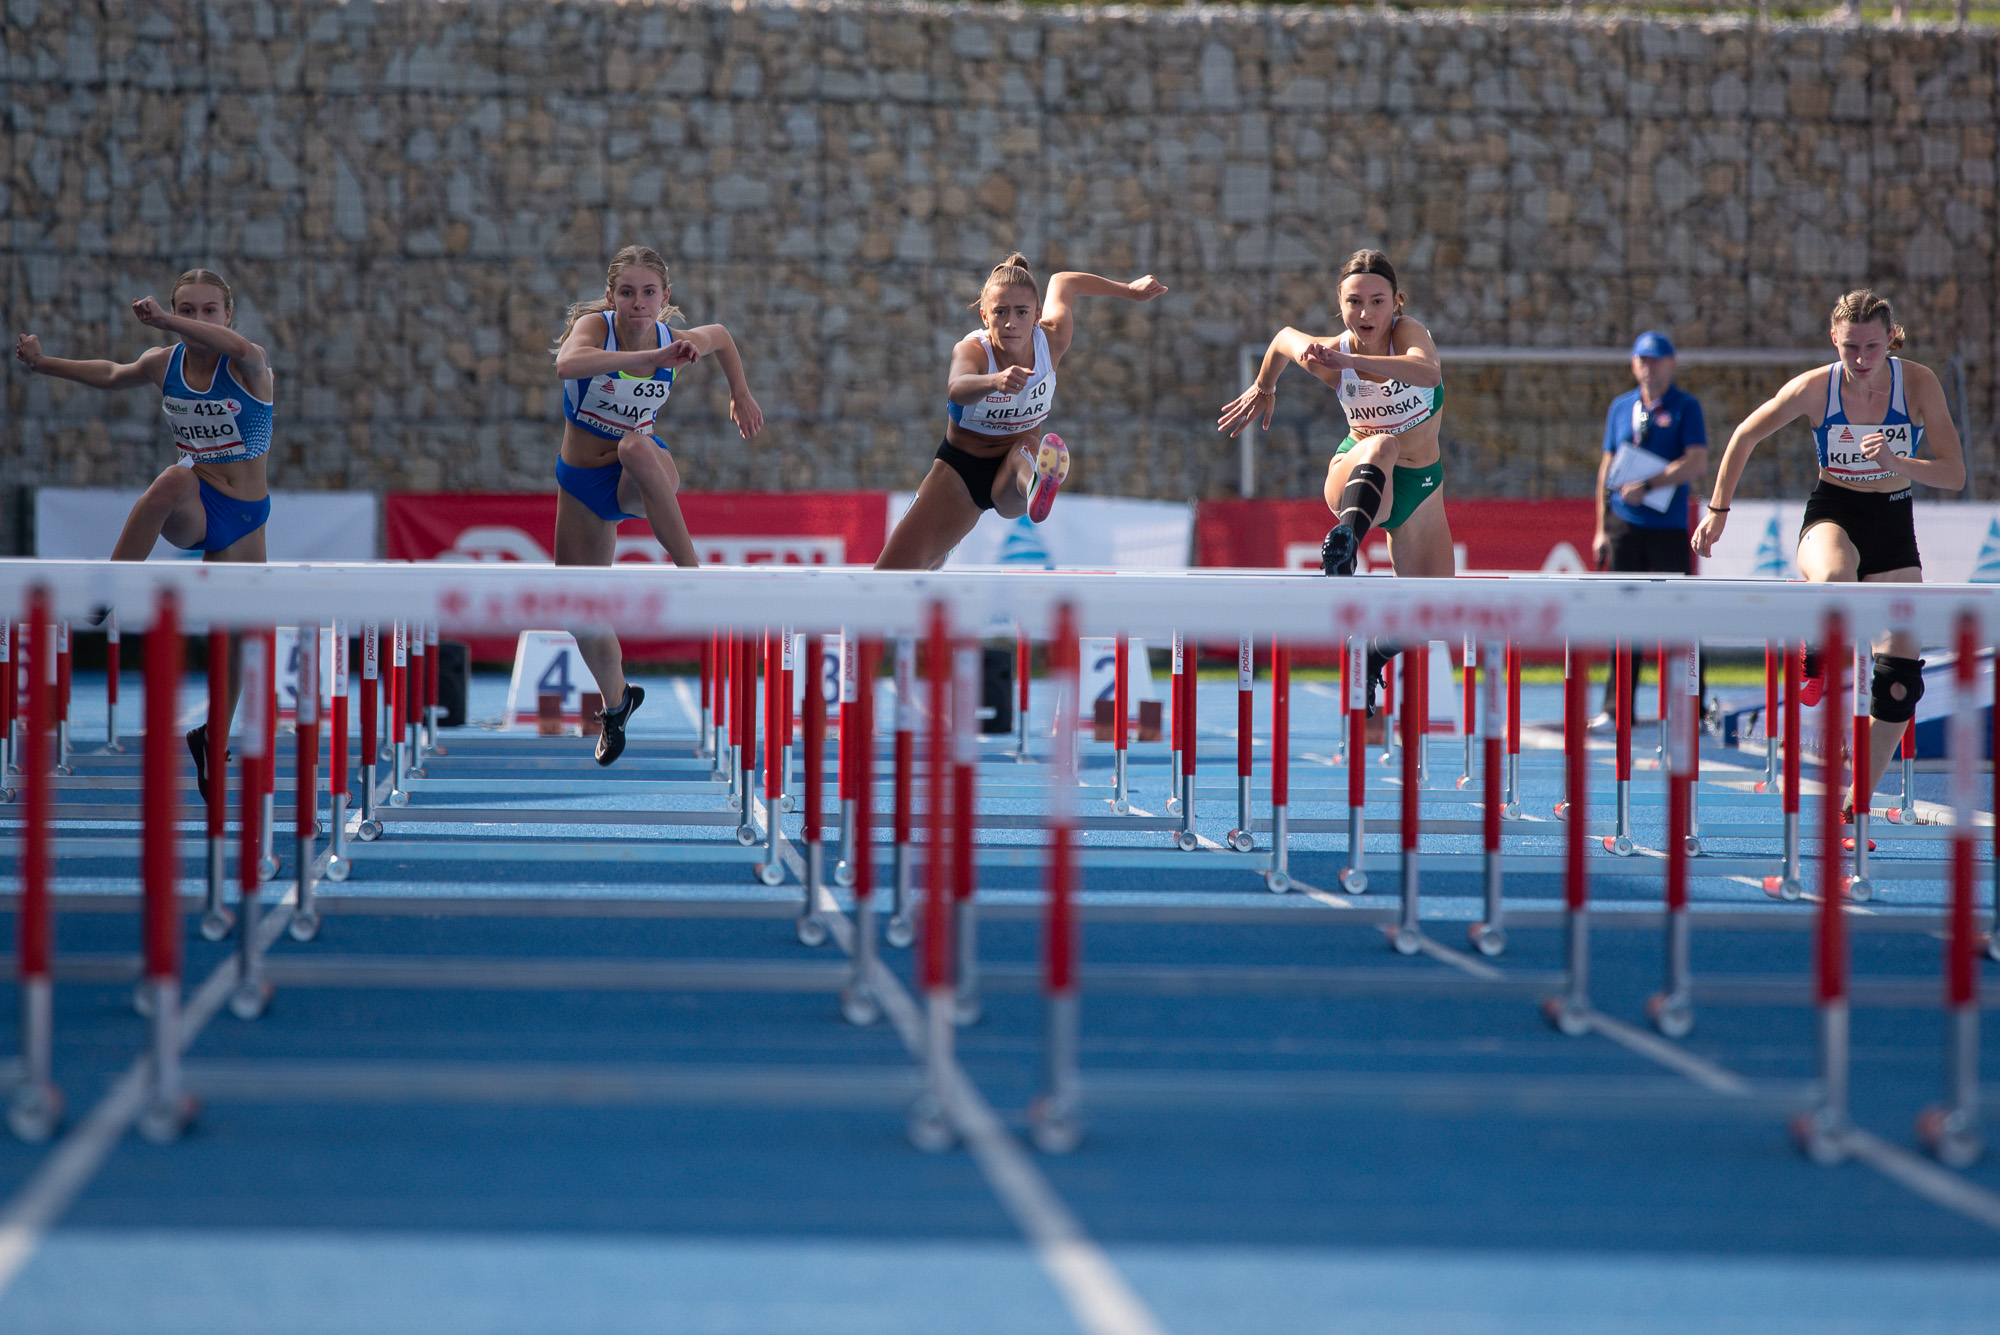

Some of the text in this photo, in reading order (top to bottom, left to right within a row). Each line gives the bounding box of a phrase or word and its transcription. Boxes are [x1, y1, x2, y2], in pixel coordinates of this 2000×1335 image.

[633, 383, 665, 398] 633
[1030, 382, 1046, 400] 10
[194, 403, 227, 416] 412
[986, 403, 1044, 419] KIELAR
[1350, 395, 1422, 420] JAWORSKA
[588, 418, 626, 437] KARPACZ
[1402, 417, 1420, 430] 2021
[1889, 491, 1905, 501] NIKE
[367, 625, 376, 661] polanik
[538, 648, 576, 704] 4
